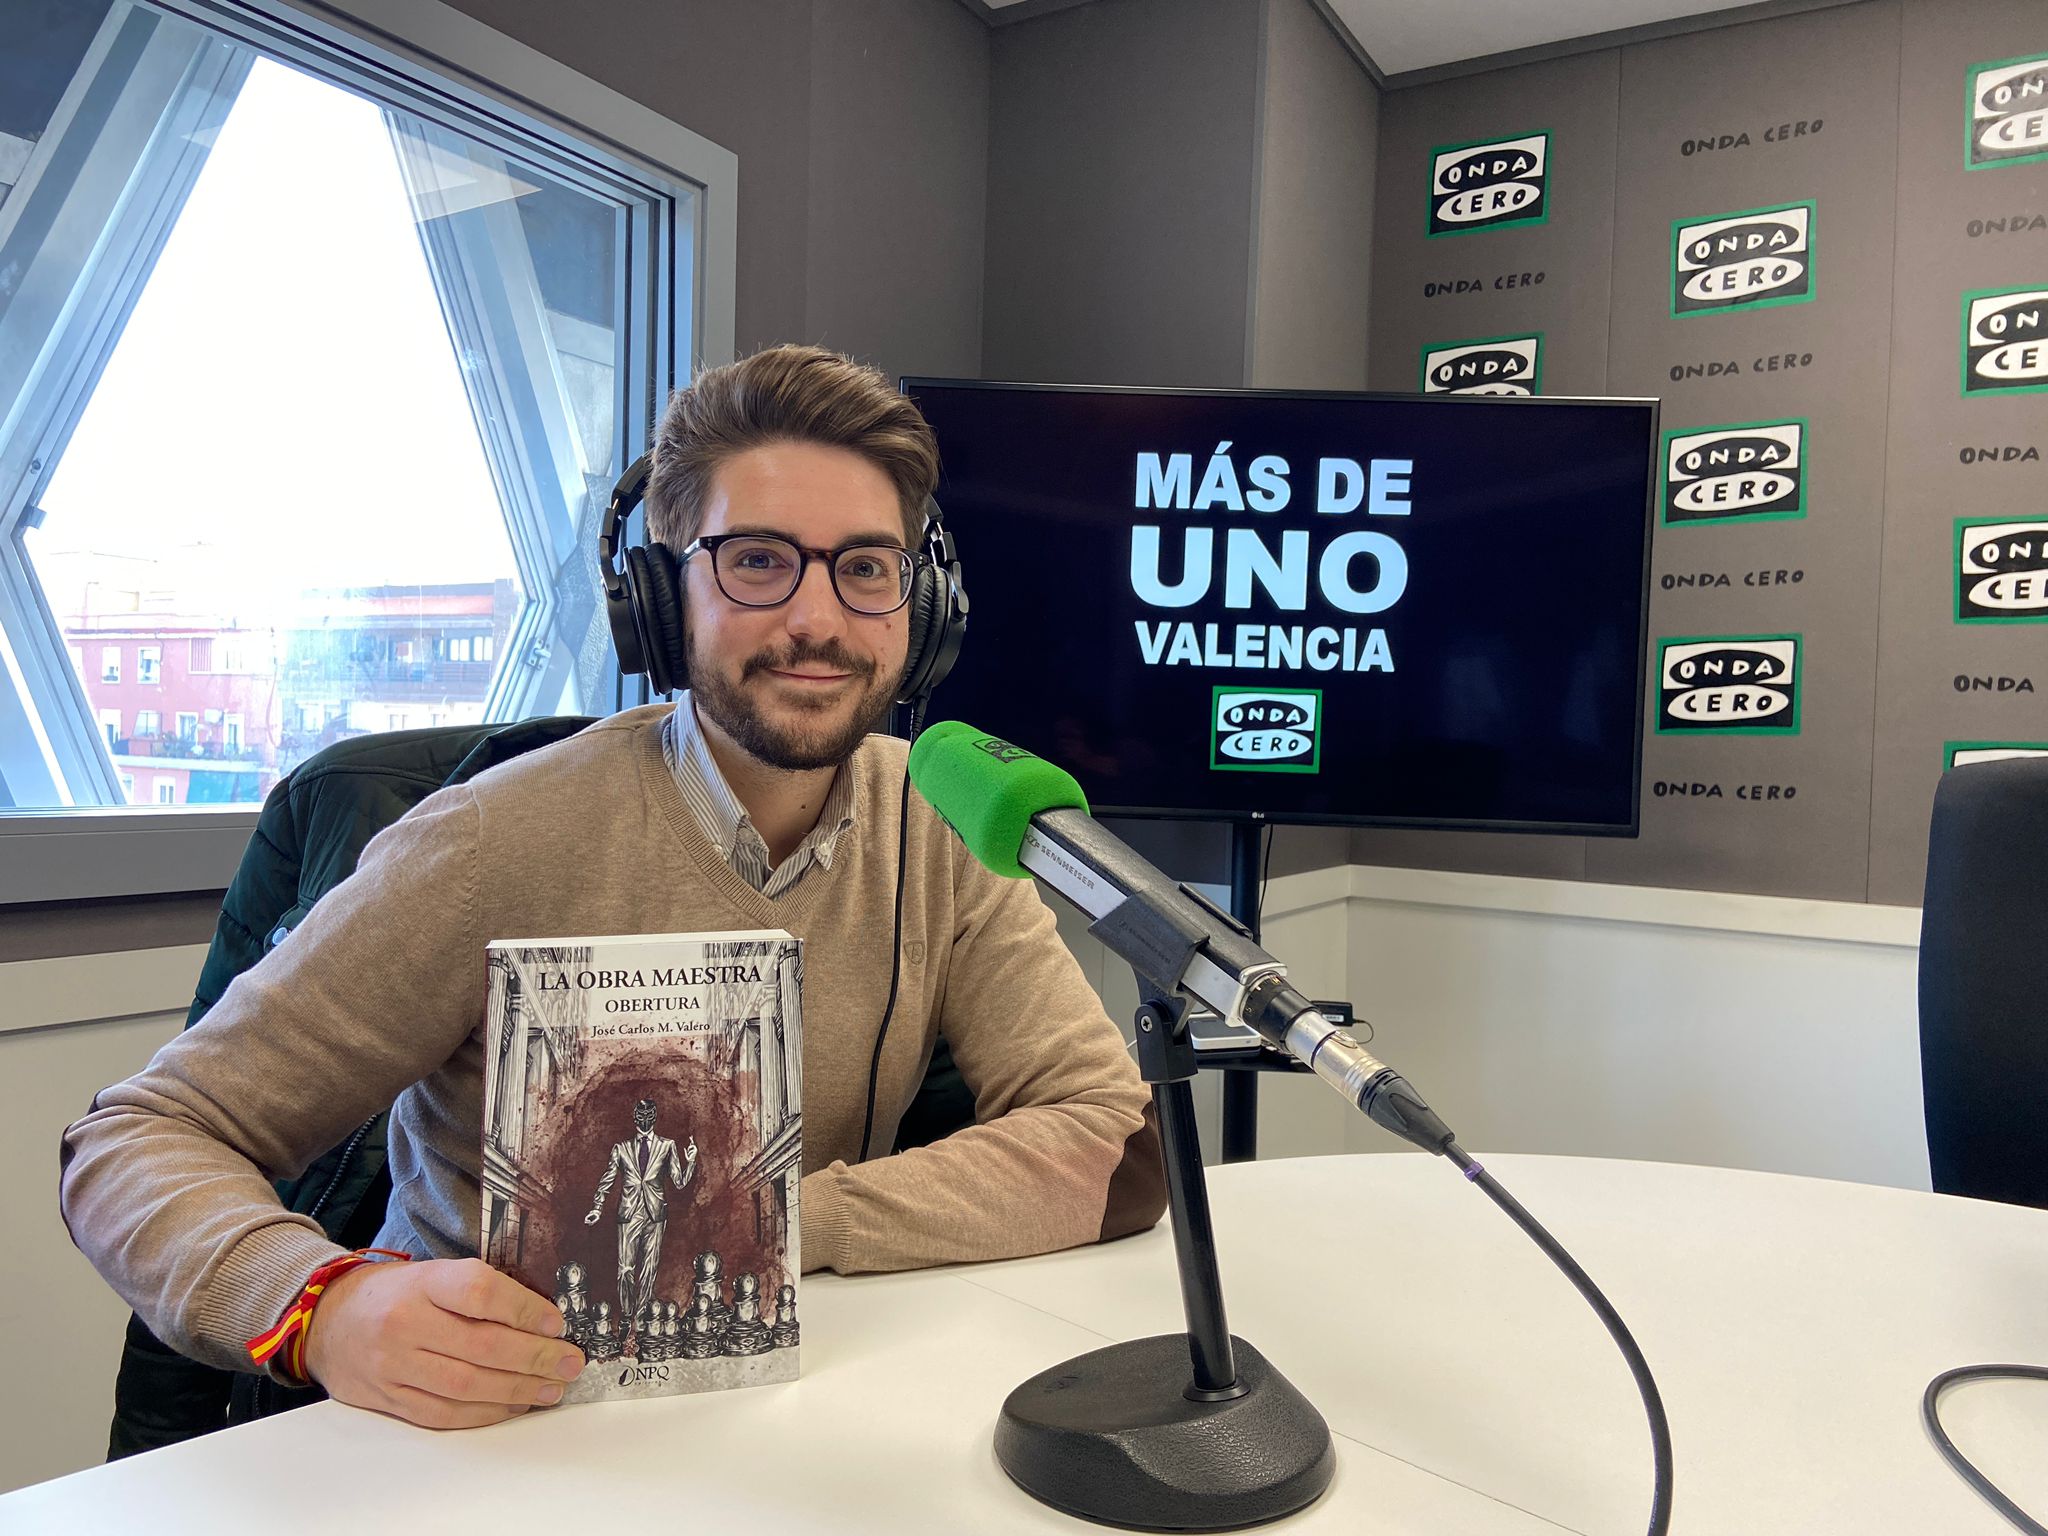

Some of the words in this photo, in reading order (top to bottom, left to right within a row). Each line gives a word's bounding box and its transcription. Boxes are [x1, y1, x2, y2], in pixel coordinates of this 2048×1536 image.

[1680, 132, 1751, 156] ONDA
[1763, 118, 1824, 143] CERO
[1448, 156, 1528, 183] ONDA
[1451, 188, 1527, 215] CERO
[1966, 214, 2048, 238] ONDA
[1694, 229, 1788, 259] ONDA
[1424, 278, 1483, 298] ONDA
[1494, 271, 1546, 290] CERO
[1699, 264, 1788, 293] CERO
[1439, 357, 1519, 382] ONDA
[1669, 361, 1740, 382] ONDA
[1753, 352, 1813, 373] CERO
[1684, 444, 1780, 470] ONDA
[1959, 446, 2040, 465] ONDA
[1134, 440, 1292, 514] MÁS
[1316, 456, 1414, 516] DE
[1689, 480, 1779, 504] CERO
[1129, 524, 1409, 614] UNO
[1661, 572, 1731, 590] ONDA
[1743, 569, 1805, 587] CERO
[1987, 577, 2048, 600] CE
[1134, 620, 1396, 673] VALENCIA
[1679, 658, 1774, 680] ONDA
[1953, 674, 2035, 693] ONDA
[1229, 706, 1302, 724] ONDA
[1683, 694, 1773, 713] CERO
[1234, 736, 1300, 752] CERO
[1653, 781, 1723, 799] ONDA
[1735, 784, 1797, 800] CERO
[1040, 845, 1095, 890] SENNHEISER
[538, 971, 571, 991] LA
[576, 969, 646, 990] OBRA
[651, 964, 763, 987] MAESTRA
[605, 996, 700, 1013] OBERTURA
[591, 1023, 616, 1038] José
[618, 1022, 655, 1035] Carlos
[657, 1022, 674, 1033] M.
[676, 1020, 711, 1032] Valero
[635, 1365, 670, 1381] NPQ
